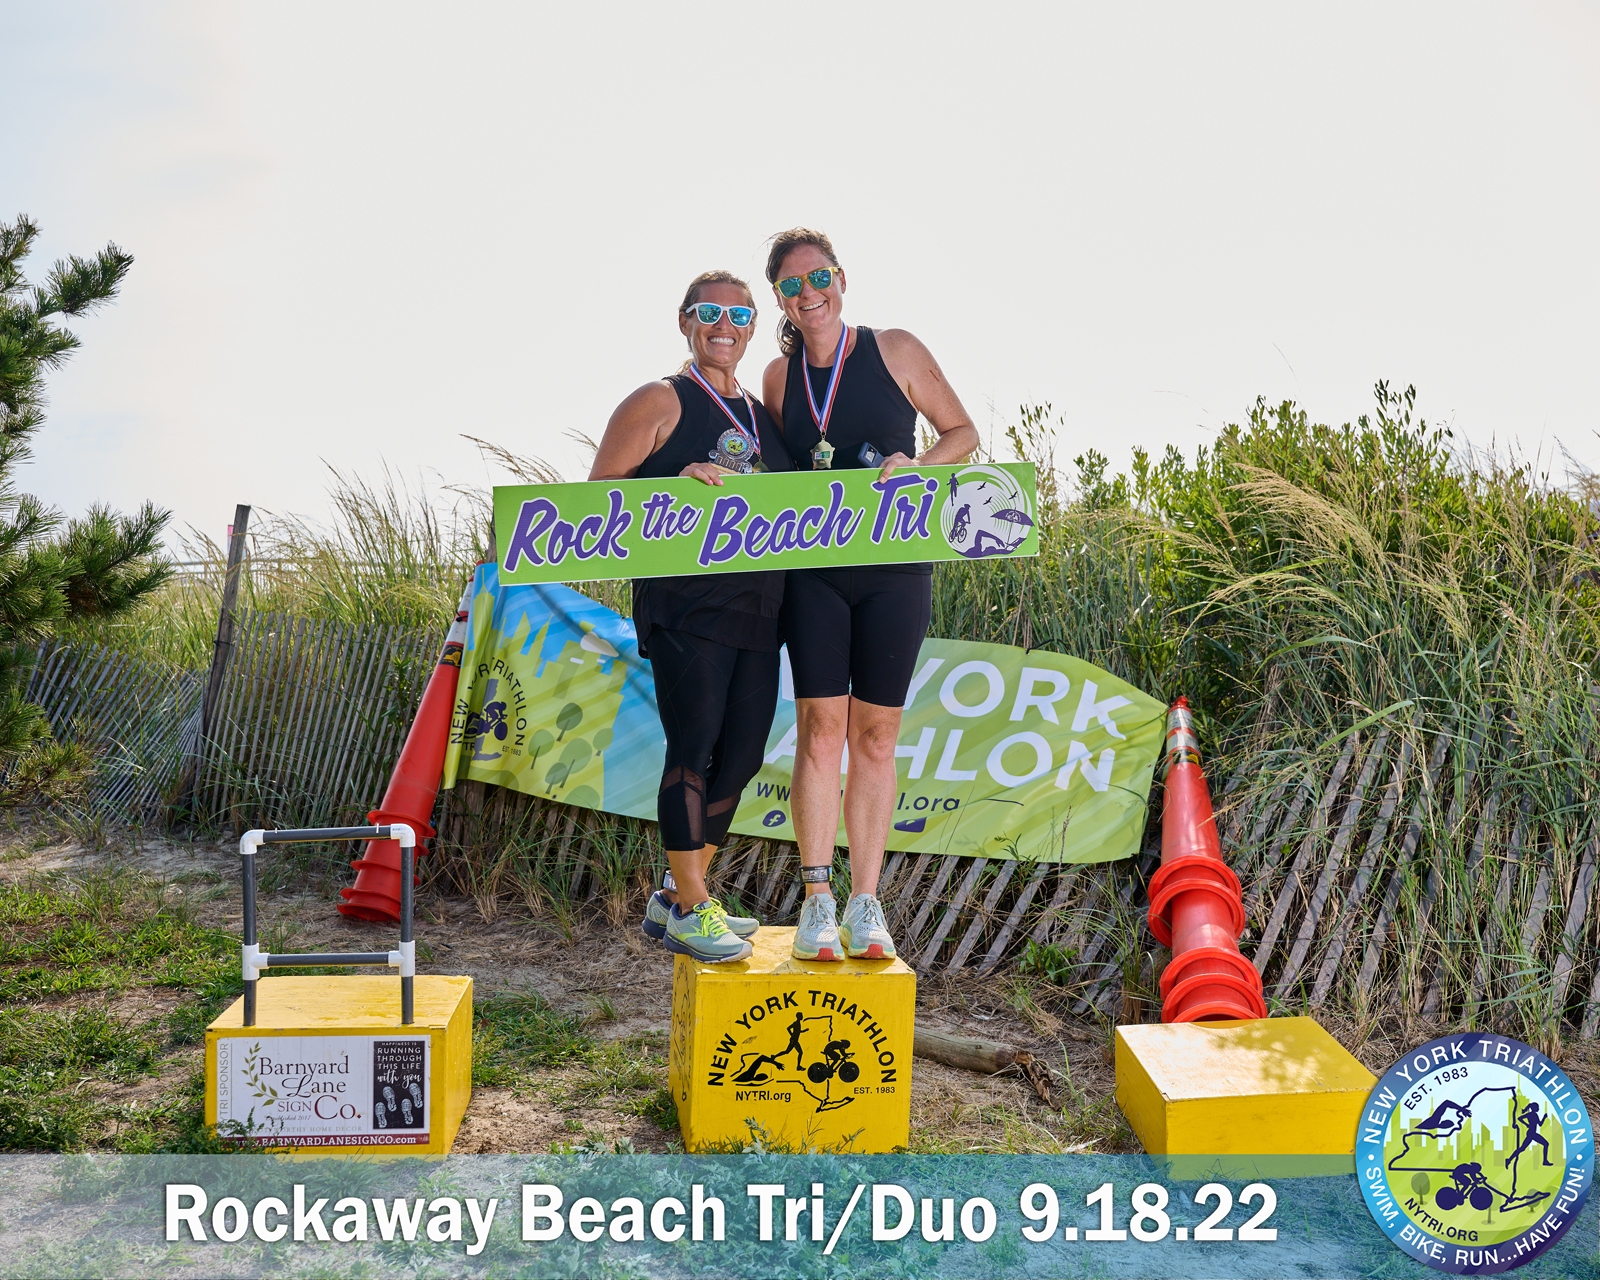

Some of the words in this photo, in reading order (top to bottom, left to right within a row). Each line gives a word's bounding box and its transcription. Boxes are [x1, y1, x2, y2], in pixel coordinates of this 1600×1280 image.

[503, 489, 632, 573] Rock
[642, 492, 703, 540] the
[698, 481, 865, 567] Beach
[871, 473, 940, 544] Tri
[450, 698, 469, 745] NEW
[491, 656, 527, 746] RIATHLON
[708, 1032, 737, 1086] NEW
[735, 990, 799, 1030] YORK
[808, 990, 897, 1083] TRIATHLON
[219, 1043, 228, 1096] SPONSOR
[259, 1055, 350, 1077] Barnyard
[401, 1062, 421, 1070] LIFE
[281, 1074, 347, 1098] Lane
[377, 1069, 399, 1084] with
[401, 1074, 421, 1089] you
[854, 1086, 873, 1095] EST.
[875, 1086, 896, 1094] 1983
[277, 1101, 312, 1112] SIGN
[314, 1094, 362, 1120] Co.
[735, 1090, 792, 1103] NYTRI.org
